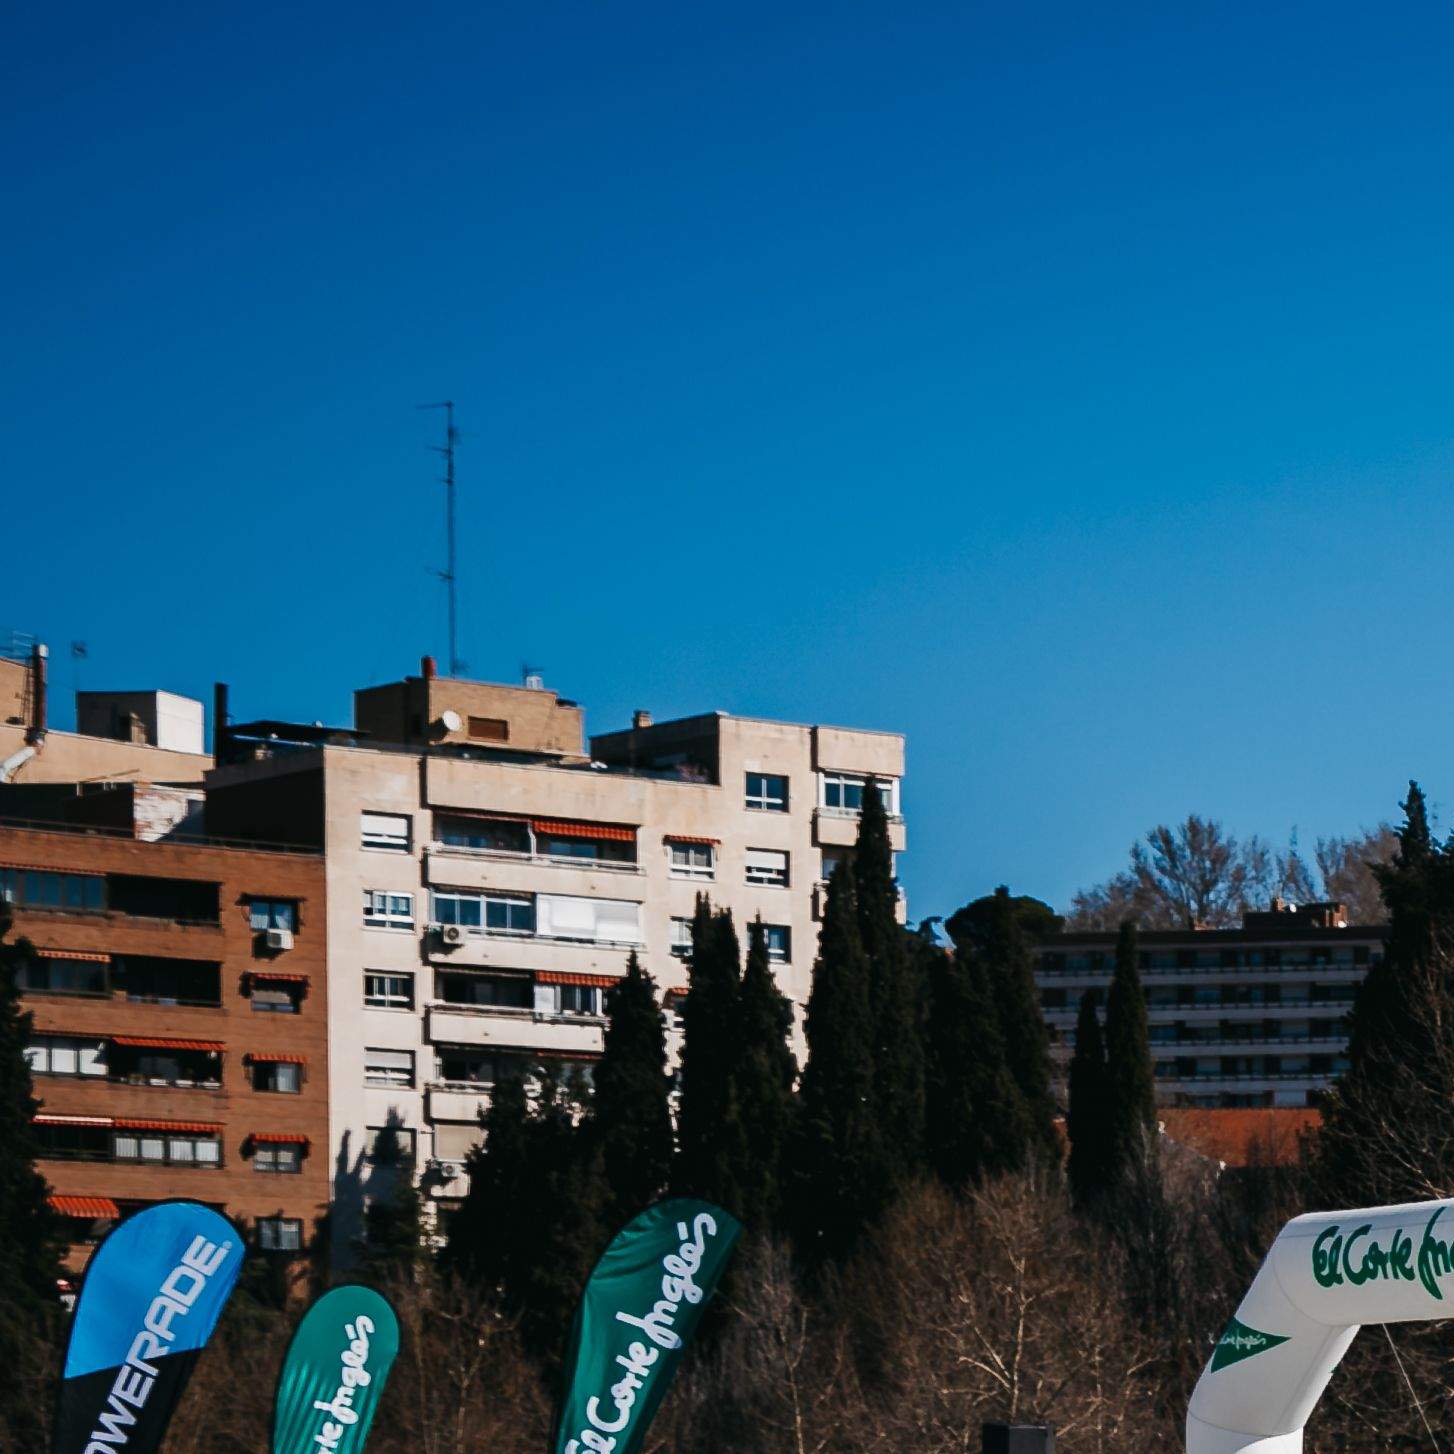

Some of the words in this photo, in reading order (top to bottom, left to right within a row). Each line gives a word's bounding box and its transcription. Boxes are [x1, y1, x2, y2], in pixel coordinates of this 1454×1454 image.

[615, 1212, 717, 1349] Inglés
[1312, 1225, 1344, 1288] El
[1343, 1224, 1415, 1285] Corte
[313, 1315, 375, 1425] Inglés
[587, 1341, 659, 1432] Corte
